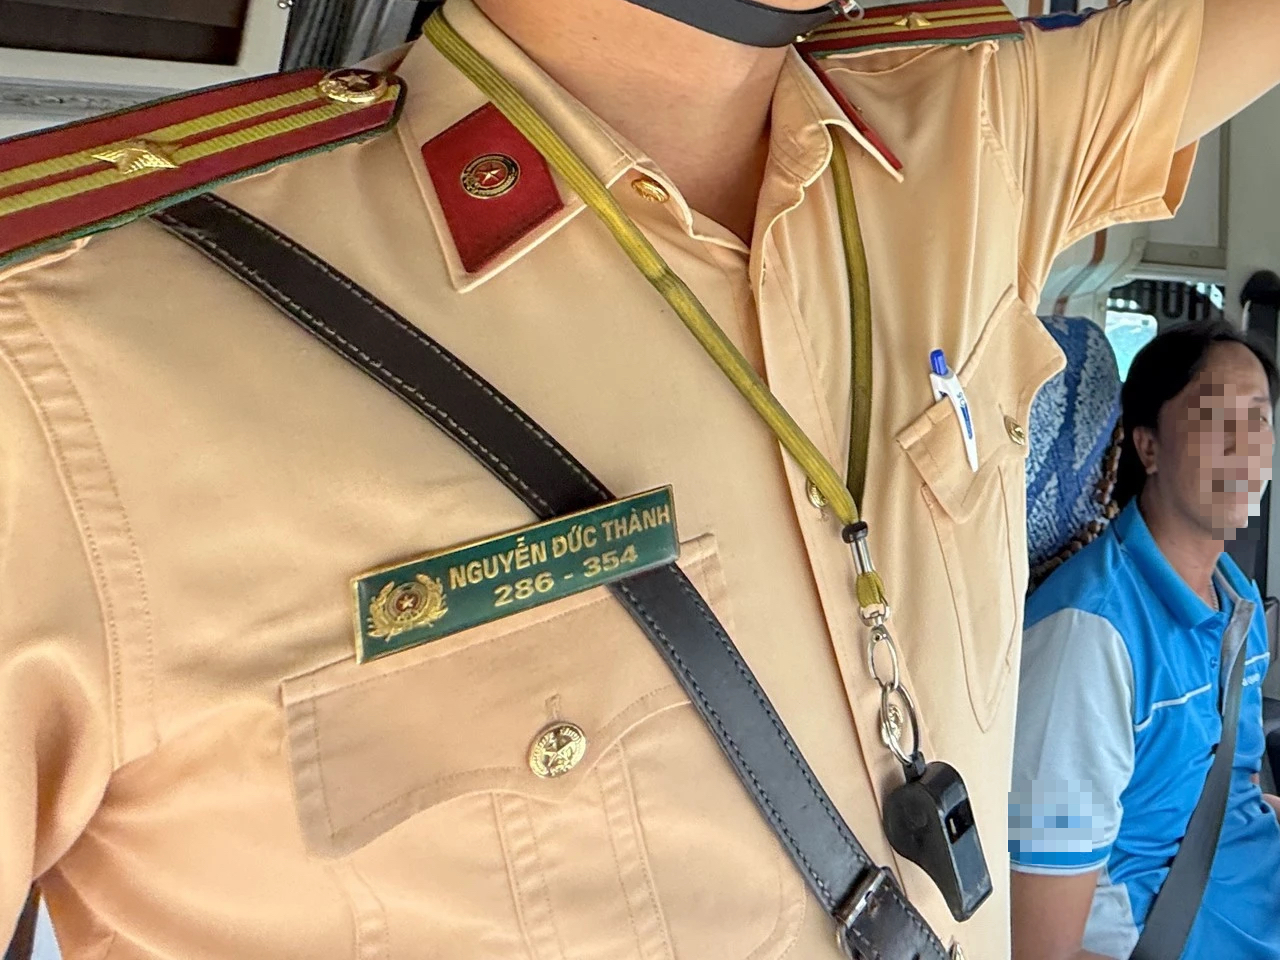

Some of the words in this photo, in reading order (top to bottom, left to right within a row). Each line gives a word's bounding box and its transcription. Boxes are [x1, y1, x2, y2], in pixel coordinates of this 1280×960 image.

[448, 537, 547, 590] NGUYỄN
[551, 524, 598, 558] ĐỨC
[601, 503, 671, 542] THÀNH
[493, 570, 555, 608] 286
[582, 543, 639, 579] 354
